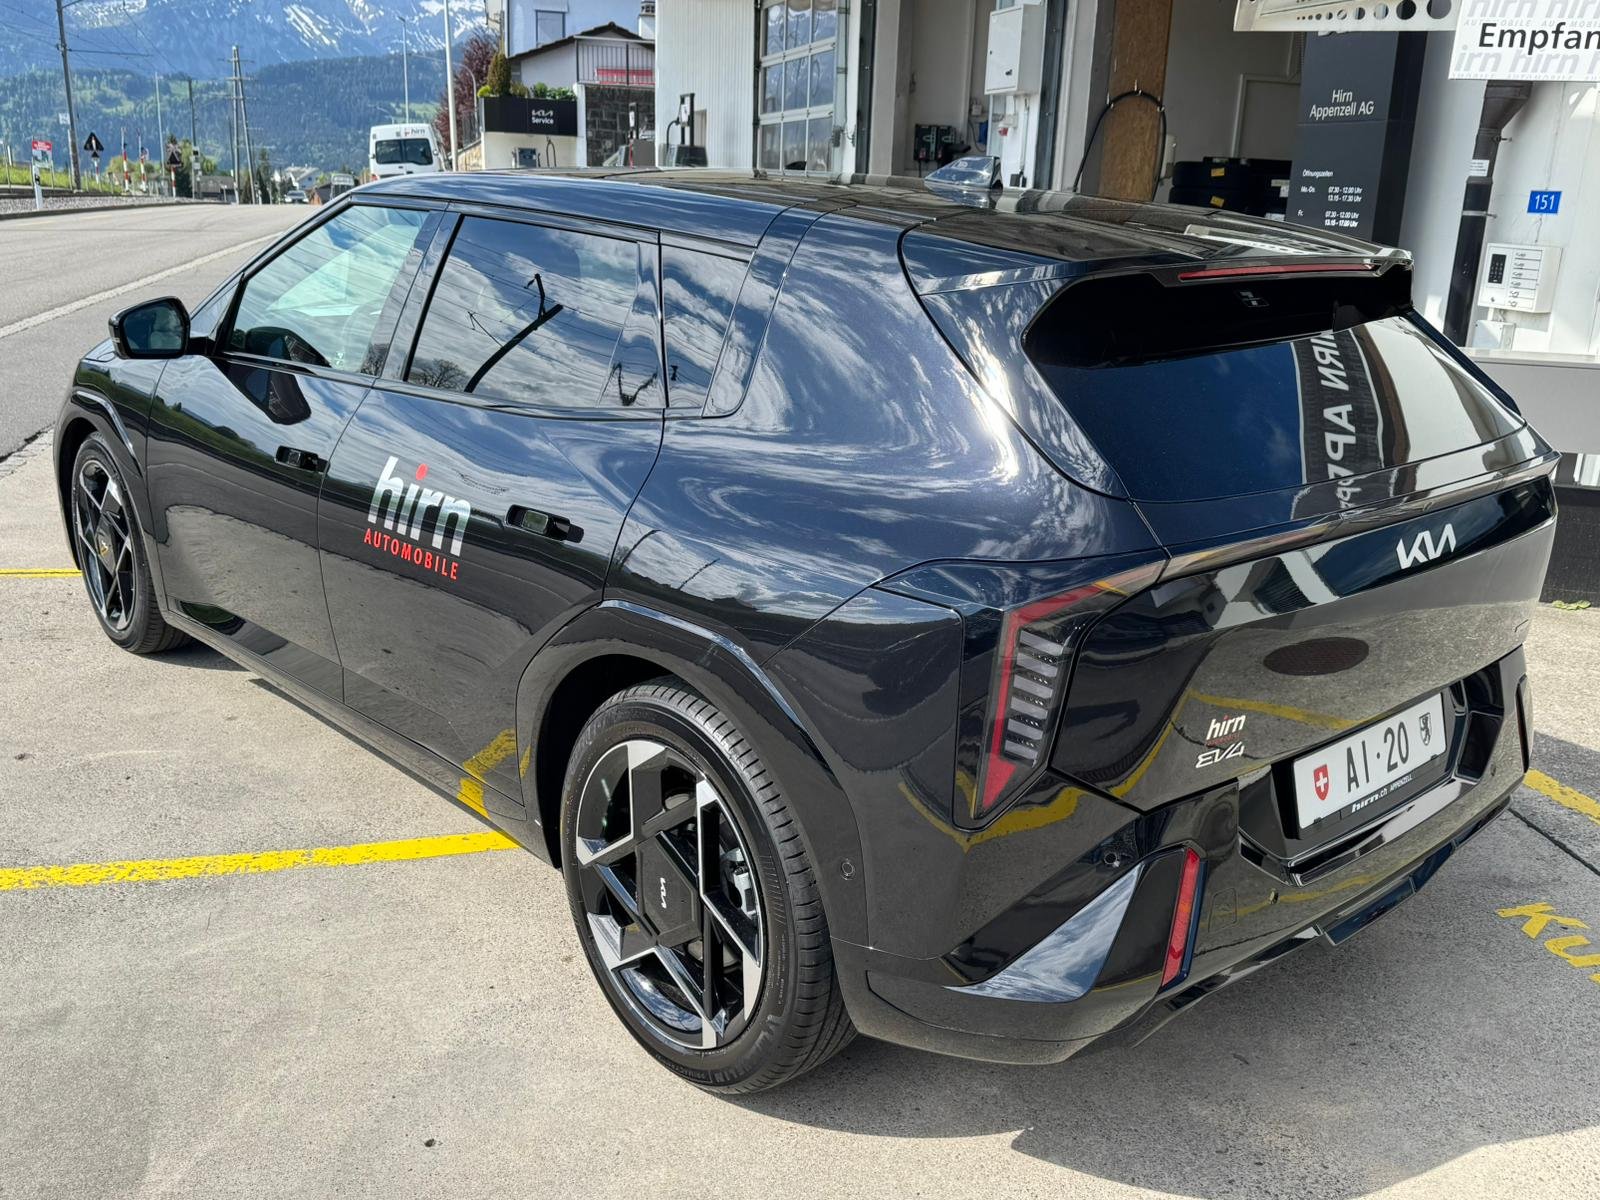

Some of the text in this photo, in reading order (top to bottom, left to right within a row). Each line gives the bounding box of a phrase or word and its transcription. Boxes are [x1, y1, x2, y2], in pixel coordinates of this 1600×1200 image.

[1332, 89, 1353, 103] Hirn
[532, 117, 554, 125] Service
[1309, 100, 1375, 120] Appenzell AG
[1534, 194, 1555, 210] 151
[367, 455, 471, 557] hirn
[363, 527, 460, 581] AUTOMOBILE
[1396, 523, 1456, 569] KIA
[1206, 714, 1246, 741] hirn
[1195, 741, 1245, 768] EV4
